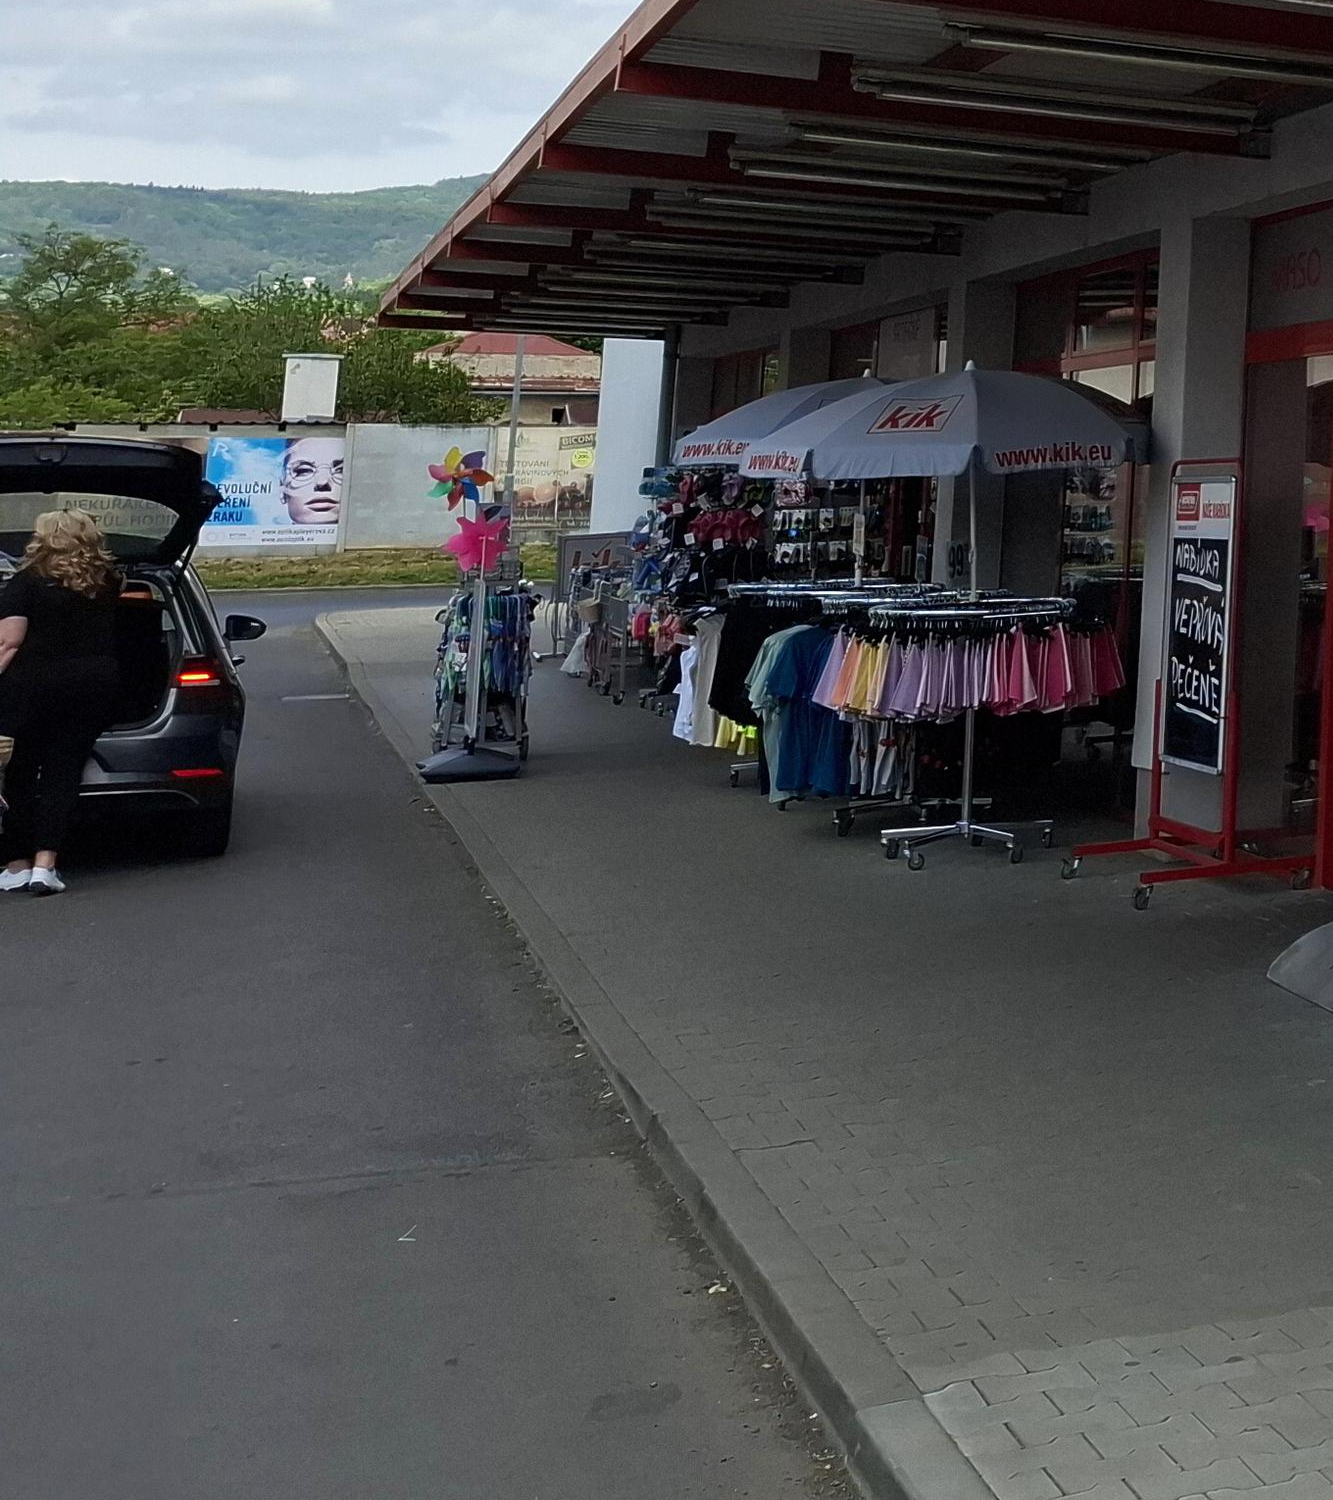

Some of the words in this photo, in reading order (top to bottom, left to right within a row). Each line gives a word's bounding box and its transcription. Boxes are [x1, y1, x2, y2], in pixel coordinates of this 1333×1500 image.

[876, 403, 948, 431] kik
[995, 441, 1113, 468] www.kik.eu
[217, 495, 251, 508] ŘENÍ
[218, 481, 273, 494] EVOLUČNÍ
[1176, 537, 1221, 579] NABÍDKA
[1173, 595, 1225, 656] VEPŘOVÁ
[1170, 654, 1221, 714] PEČENĚ
